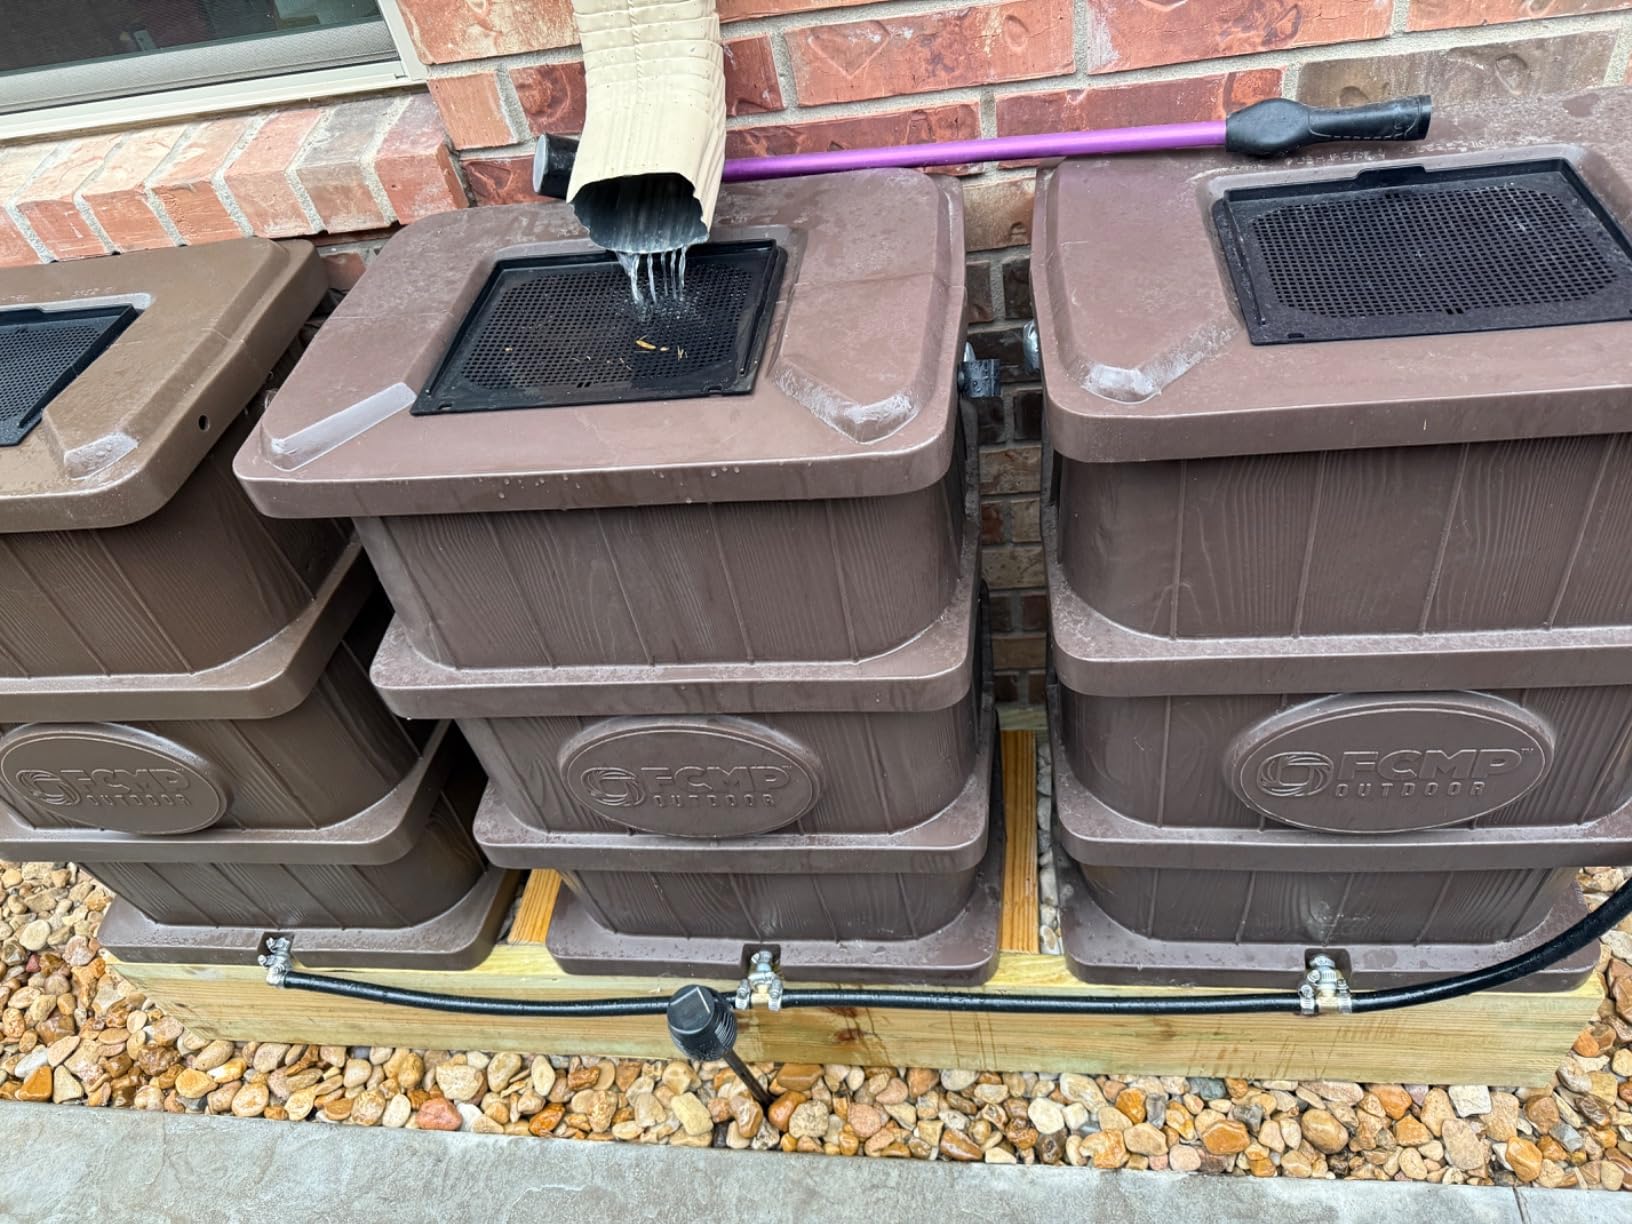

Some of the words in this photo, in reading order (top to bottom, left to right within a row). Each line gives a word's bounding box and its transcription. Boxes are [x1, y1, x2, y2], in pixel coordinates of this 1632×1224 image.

[1336, 748, 1523, 781] FCMP
[59, 767, 190, 794] FCMP
[639, 765, 792, 792] FCMP
[1335, 782, 1486, 798] OUTDOOR
